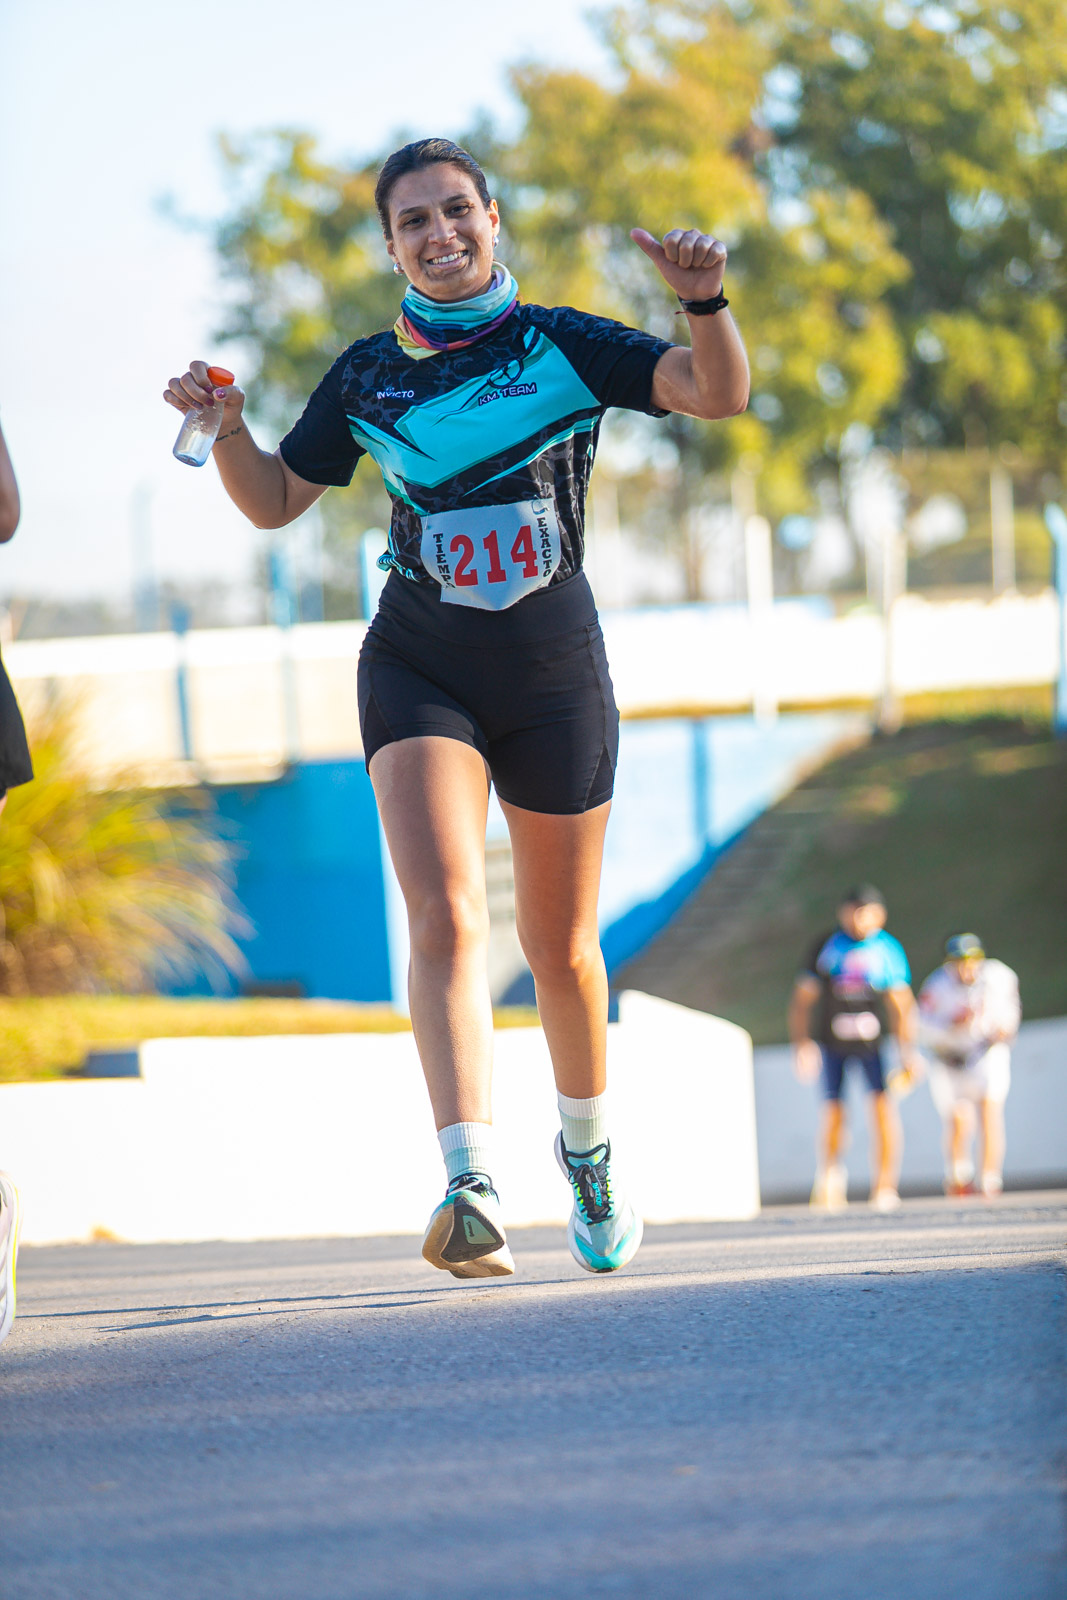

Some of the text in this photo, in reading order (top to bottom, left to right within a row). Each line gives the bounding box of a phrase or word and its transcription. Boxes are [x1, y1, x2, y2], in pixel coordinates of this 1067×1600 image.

[376, 390, 415, 400] INVICTO
[502, 384, 536, 397] TEAM
[450, 525, 539, 587] 214
[537, 517, 552, 578] EXACTO
